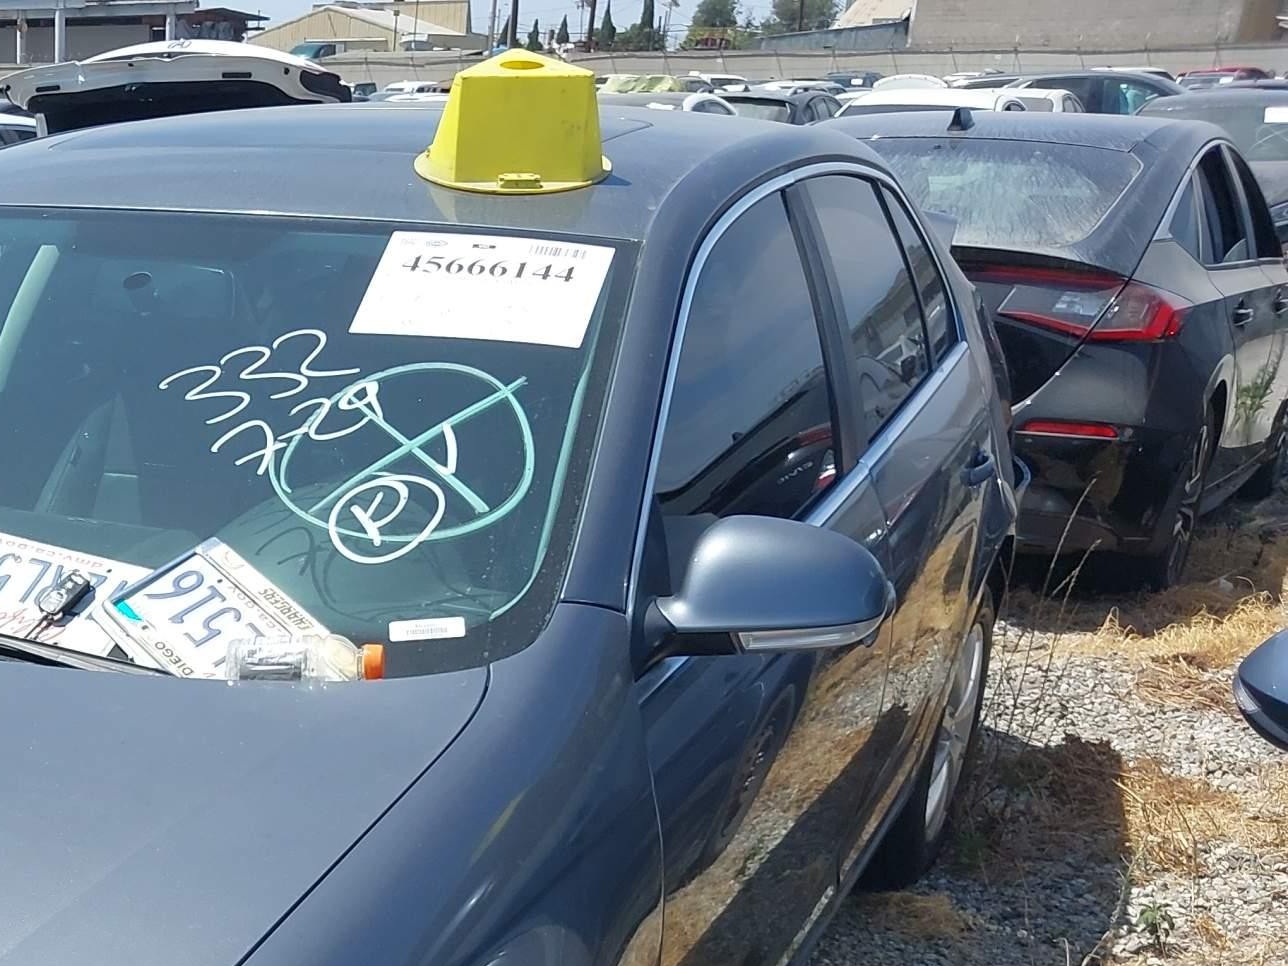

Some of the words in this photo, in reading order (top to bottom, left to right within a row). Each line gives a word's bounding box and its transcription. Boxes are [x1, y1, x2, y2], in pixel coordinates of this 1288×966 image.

[402, 254, 576, 283] 45666144
[158, 328, 361, 425] 332
[258, 587, 314, 630] CHARGERS
[154, 641, 194, 676] DIEGO
